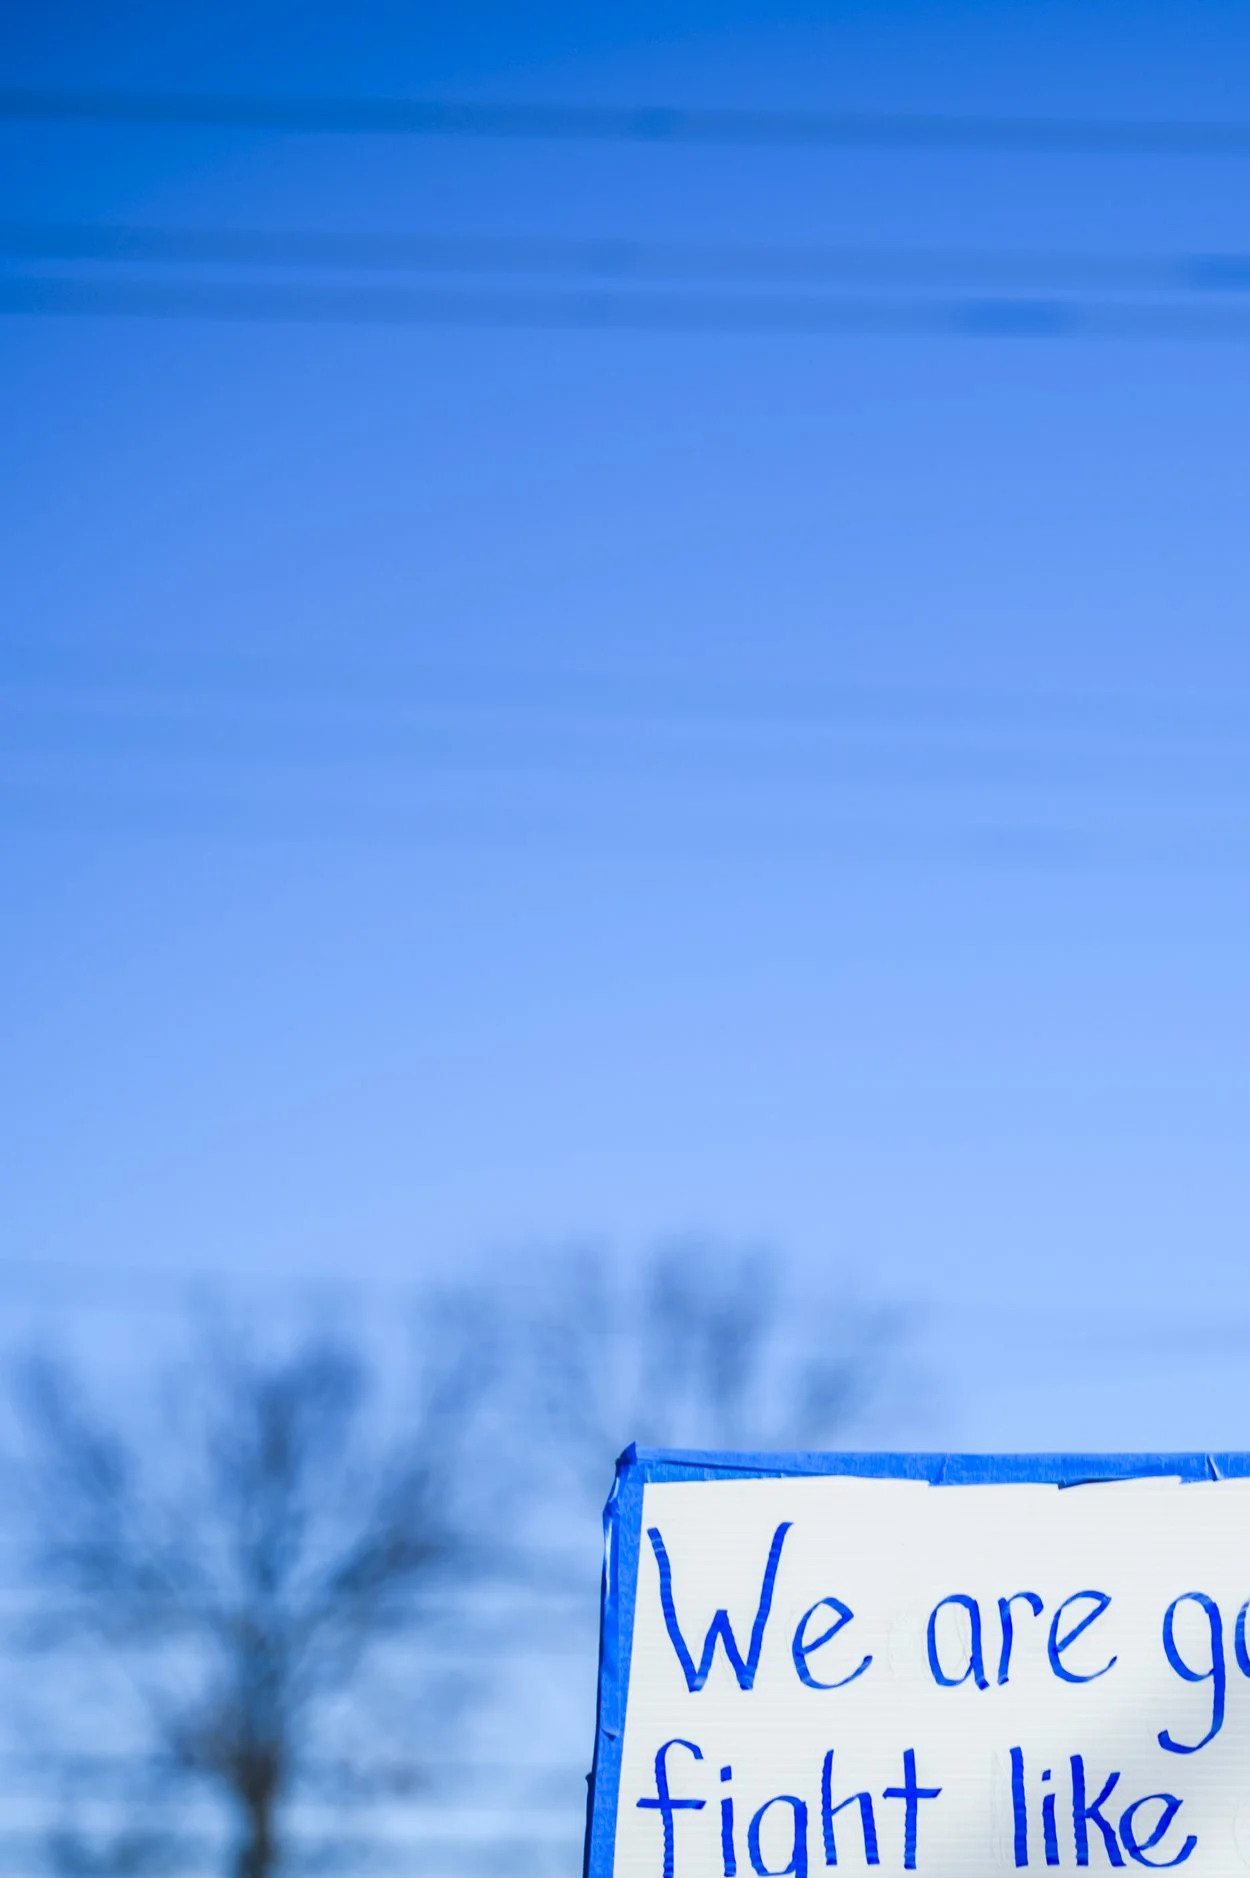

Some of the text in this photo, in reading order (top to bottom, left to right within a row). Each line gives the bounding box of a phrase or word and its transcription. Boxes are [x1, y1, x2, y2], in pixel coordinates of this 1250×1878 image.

[646, 1521, 874, 1694] We
[925, 1589, 1119, 1693] are
[1008, 1744, 1200, 1872] like
